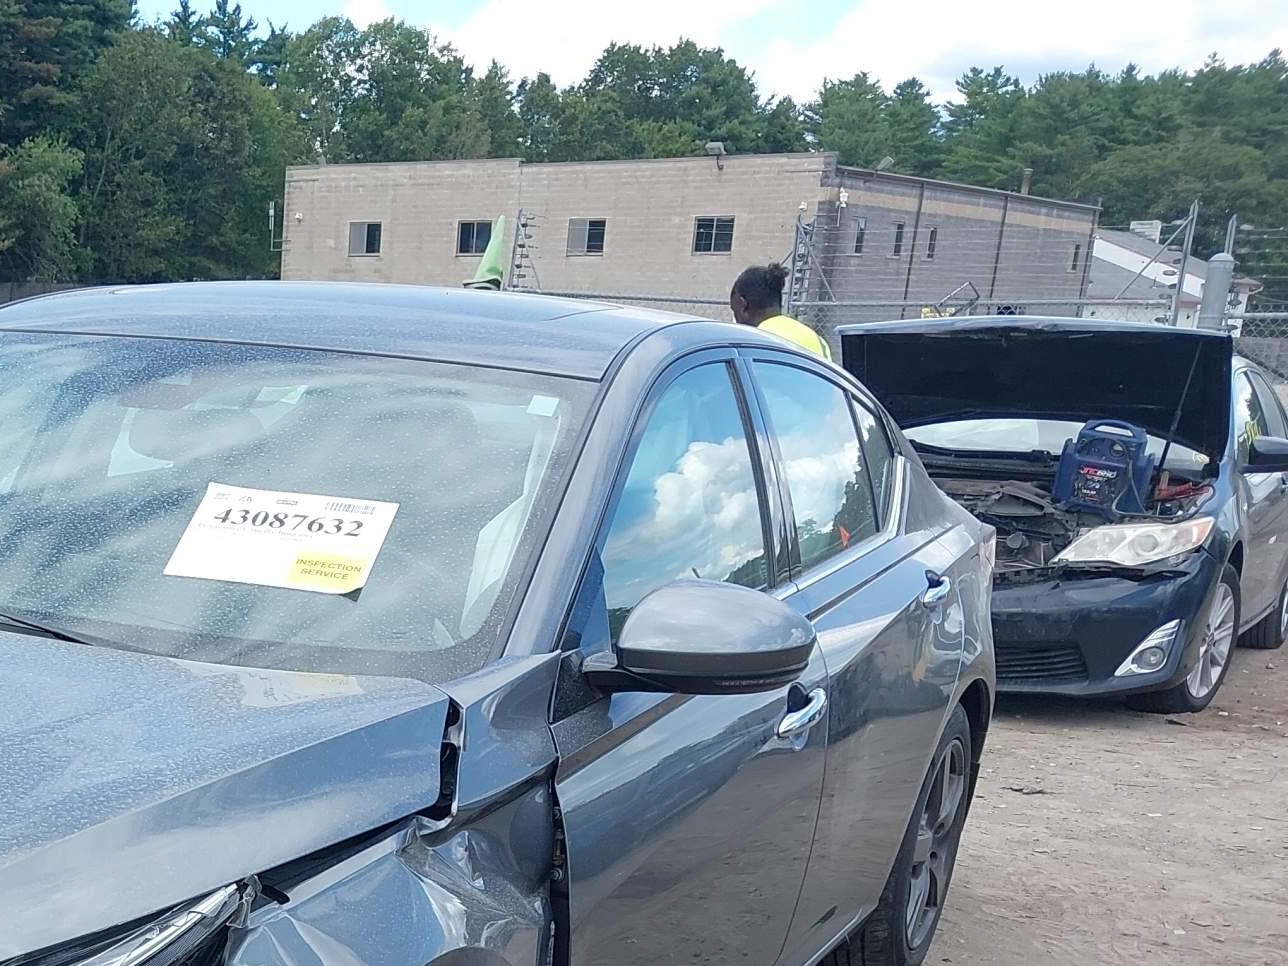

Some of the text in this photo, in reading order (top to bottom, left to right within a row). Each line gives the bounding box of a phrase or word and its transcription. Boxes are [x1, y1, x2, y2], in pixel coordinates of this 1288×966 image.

[213, 508, 364, 537] 43087632
[296, 558, 362, 573] INSPECTION
[300, 568, 349, 580] SERVICE
